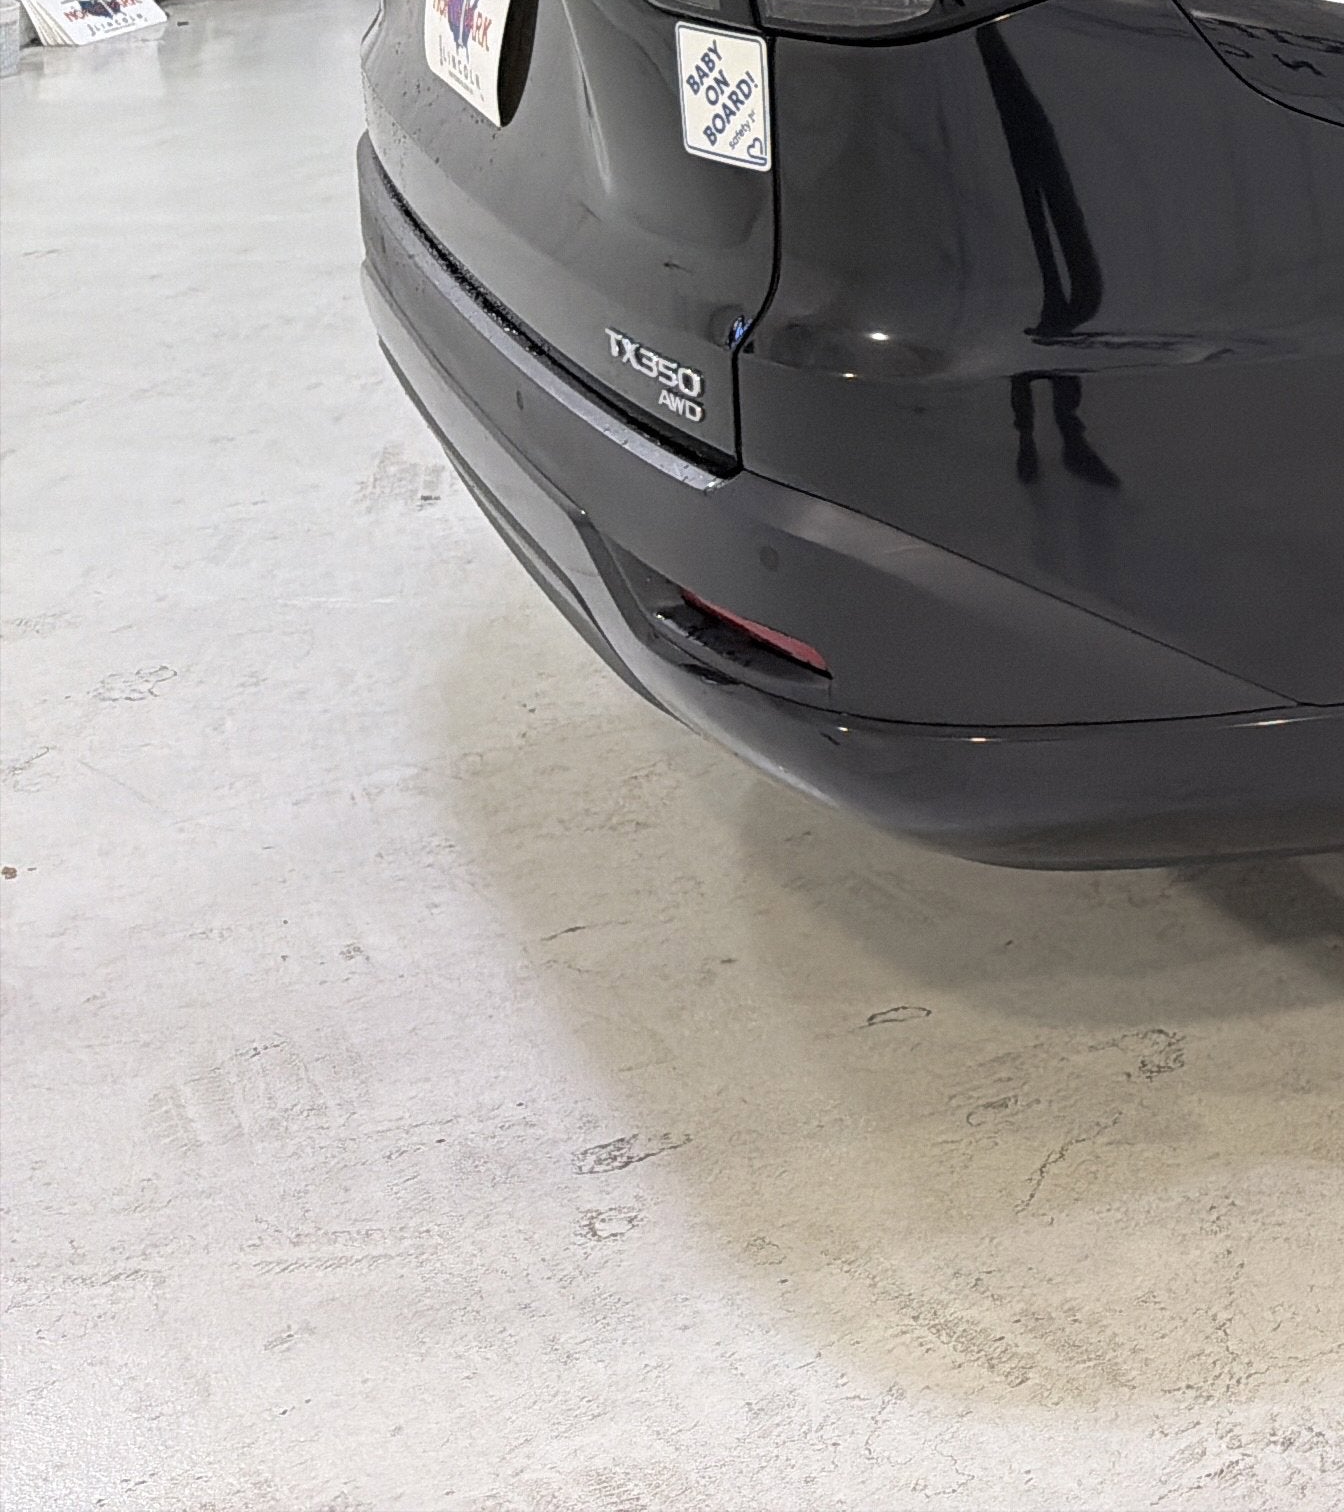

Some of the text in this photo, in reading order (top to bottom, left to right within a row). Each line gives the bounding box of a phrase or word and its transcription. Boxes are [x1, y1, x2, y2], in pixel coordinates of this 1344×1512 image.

[686, 39, 722, 95] BABY
[705, 69, 730, 106] ON
[703, 70, 759, 146] BOARD!
[604, 328, 702, 398] TX350
[658, 389, 703, 421] AWD
